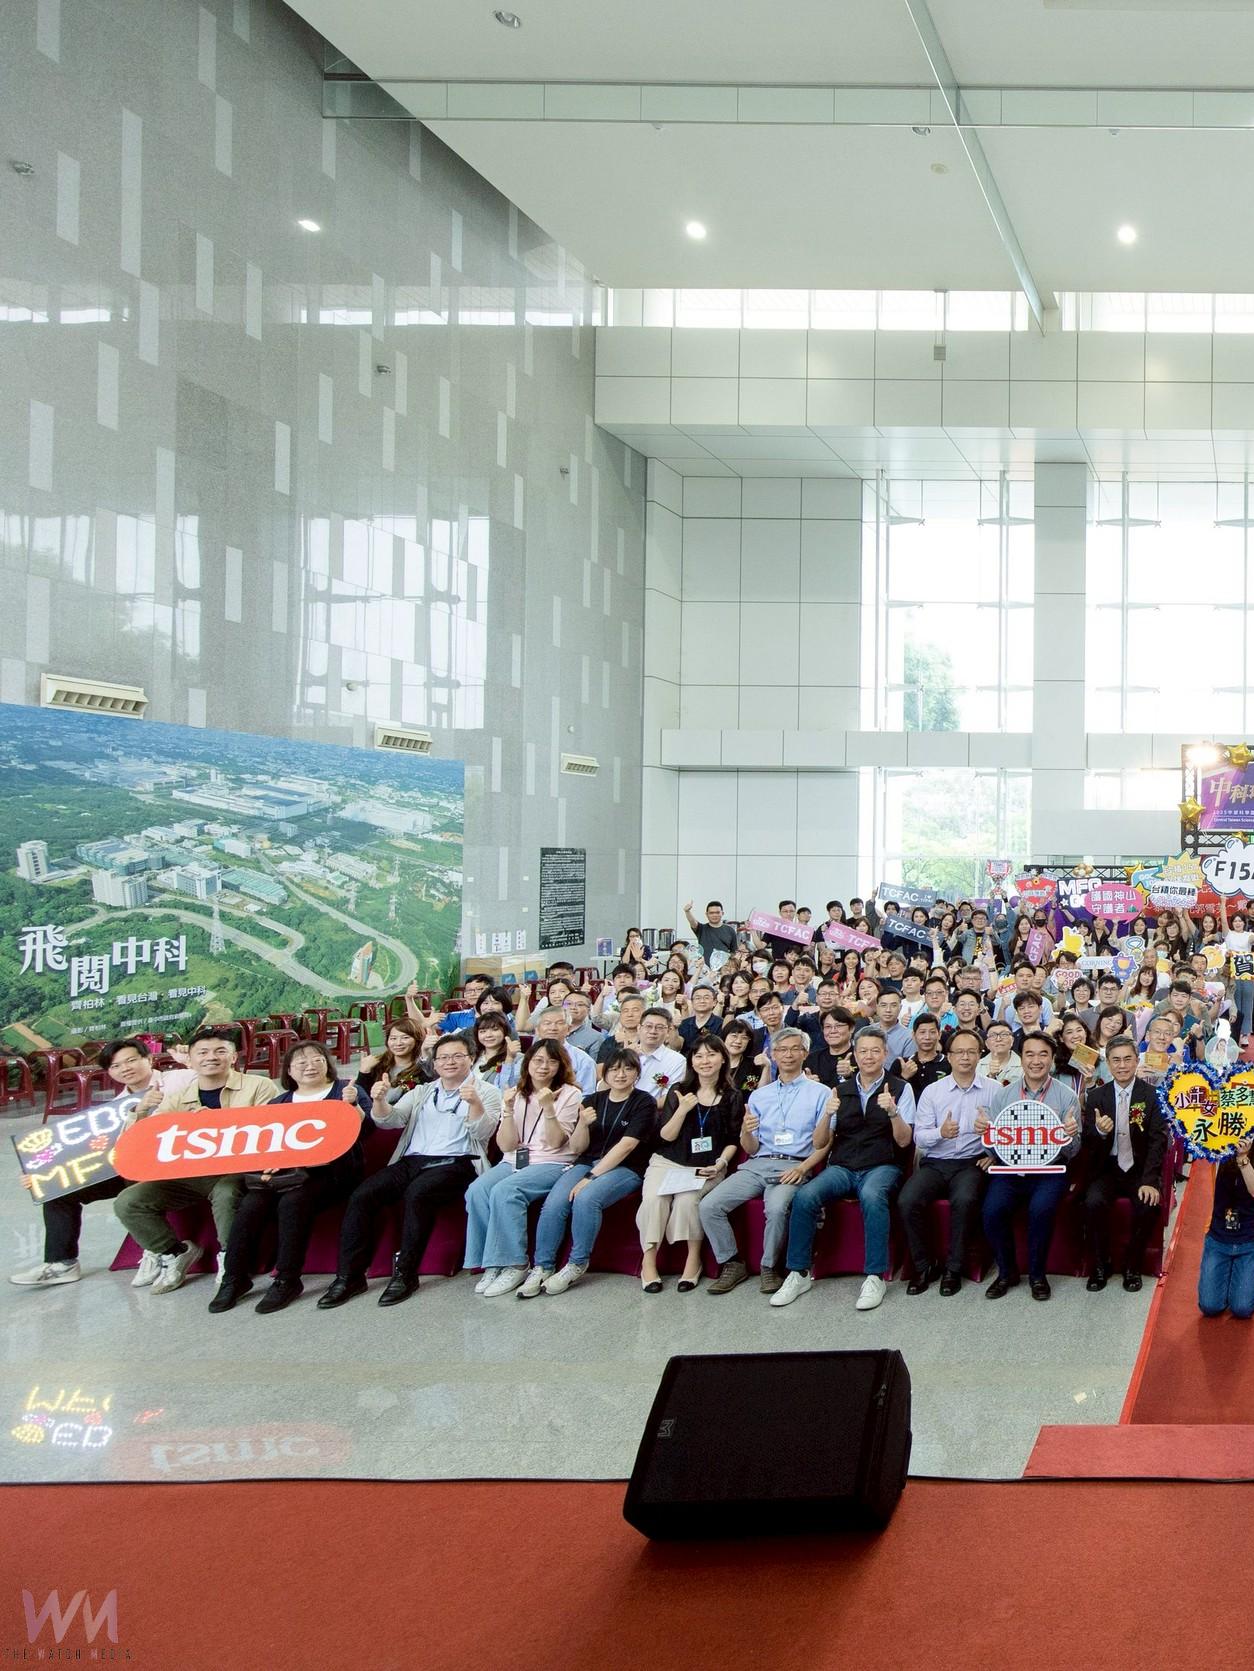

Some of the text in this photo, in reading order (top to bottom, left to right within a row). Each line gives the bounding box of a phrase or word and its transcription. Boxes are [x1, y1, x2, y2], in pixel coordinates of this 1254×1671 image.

[882, 886, 919, 903] TCFAC
[1090, 889, 1136, 902] 護國神山
[1092, 903, 1125, 914] 守護者
[773, 922, 811, 940] TCFAC
[887, 919, 926, 939] TCFAC
[1028, 933, 1043, 963] CFAC
[19, 924, 189, 997] 飛閱中科
[1055, 970, 1081, 978] GOOD
[983, 1123, 1071, 1146] tsmc
[1193, 1112, 1245, 1142] 永勝
[156, 1119, 327, 1163] tsmc
[30, 1148, 119, 1199] MF
